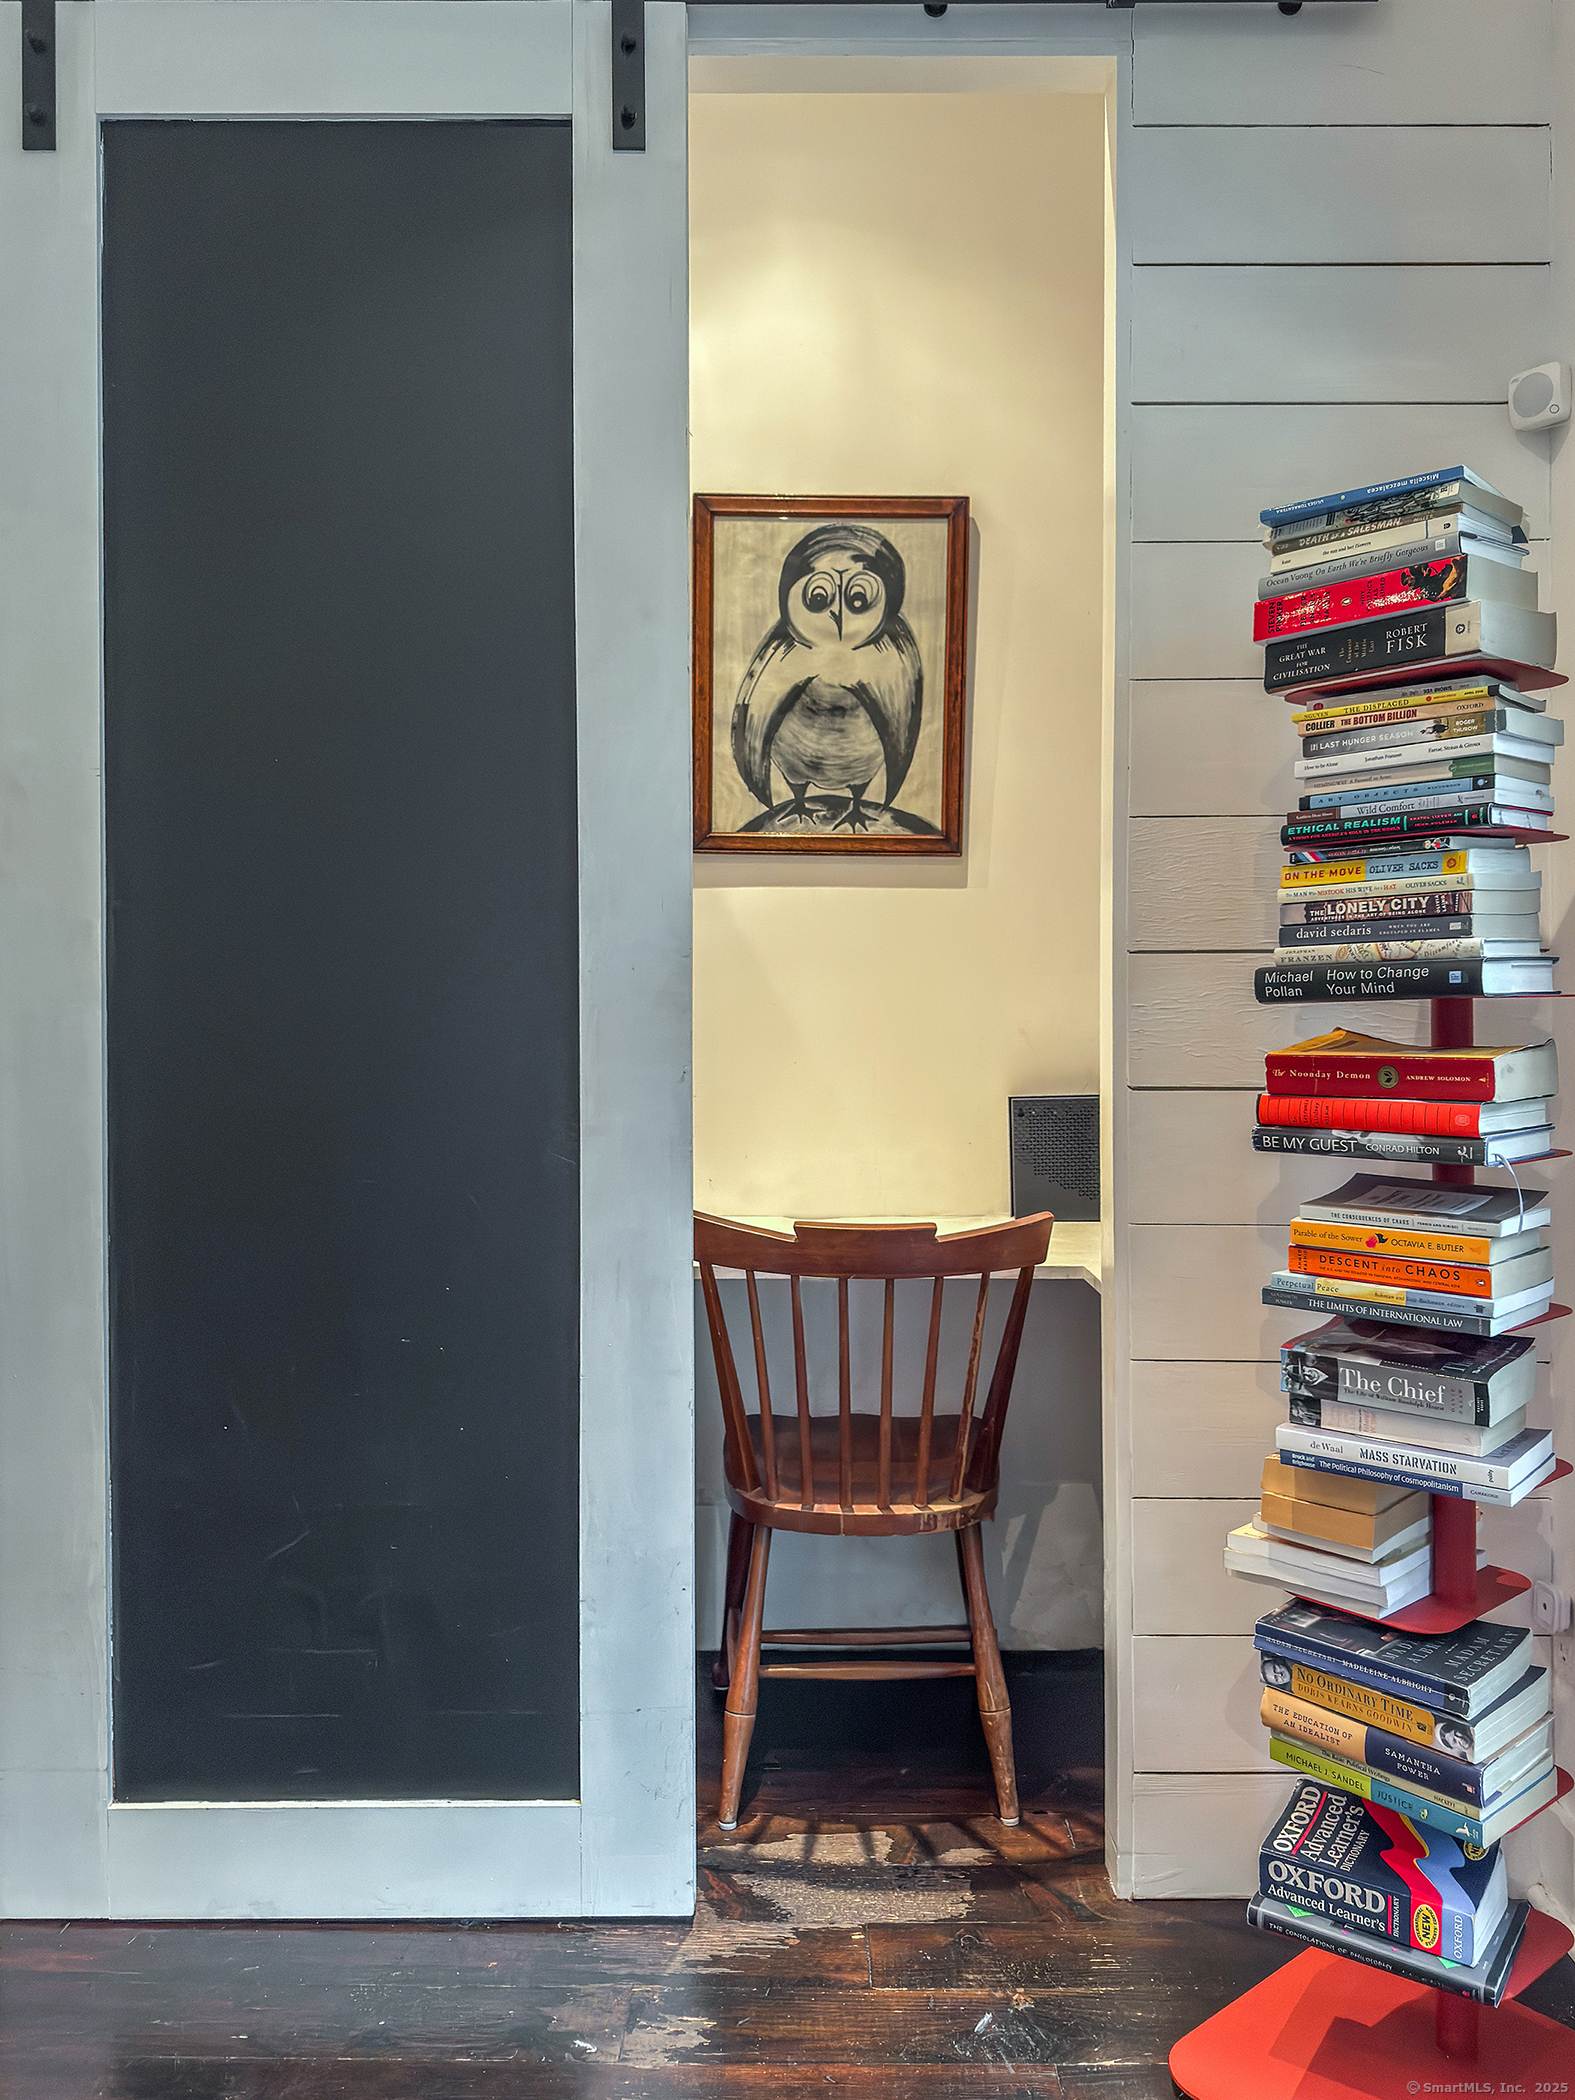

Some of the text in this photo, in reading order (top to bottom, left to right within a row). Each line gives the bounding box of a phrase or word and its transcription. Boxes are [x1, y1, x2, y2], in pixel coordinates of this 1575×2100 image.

[1409, 473, 1440, 485] Miscella
[1299, 531, 1329, 547] DEATH
[1348, 516, 1402, 536] SALESMAN
[1315, 568, 1326, 576] On
[1328, 562, 1347, 573] Earth
[1348, 558, 1368, 568] We're
[1370, 551, 1393, 562] Briefly
[1395, 544, 1429, 558] Gorgeous
[1266, 571, 1313, 587] Ocean Vuong
[1386, 622, 1428, 639] ROBERT
[1296, 643, 1308, 651] THE
[1386, 633, 1428, 654] FISK
[1279, 646, 1327, 663] GREAT WAR
[1272, 664, 1331, 681] CIVILISATION
[1364, 699, 1410, 710] DISPLACED
[1456, 702, 1484, 710] OXFORD
[1306, 720, 1335, 732] COLLIER
[1354, 713, 1386, 726] BOTTOM
[1387, 709, 1418, 720] BILLION
[1320, 730, 1414, 750] LAST HUNGER SEASON
[1318, 788, 1418, 804] ART OBJECTS
[1356, 803, 1376, 814] Wild
[1378, 796, 1414, 812] Comfort
[1288, 816, 1400, 835] ETHICAL REALISM
[1285, 866, 1361, 880] ON THE MOVE
[1370, 860, 1438, 874] OLIVER SACKS
[1327, 900, 1386, 915] LONELY
[1391, 896, 1430, 910] CITY
[1296, 924, 1372, 938] david sedaris
[1281, 954, 1333, 963] FRANZEN
[1265, 966, 1429, 984] Michael How to Change
[1266, 982, 1394, 998] Pollan Your Mind
[1272, 1068, 1371, 1080] The Noonday Demon
[1262, 1136, 1440, 1155] BE MY GUEST CONRAD HILTON
[1342, 1214, 1381, 1223] CONSEQUENCES
[1294, 1228, 1317, 1238] Parable
[1328, 1231, 1339, 1240] the
[1340, 1234, 1362, 1242] Sower
[1391, 1238, 1464, 1252] OCTAVIA E. BUTLER
[1320, 1255, 1460, 1281] DESCENT into CHAOS
[1276, 1278, 1339, 1293] Perpetual Peace
[1308, 1298, 1462, 1328] THE LIMITS OF INTERNATIONAL LAW
[1340, 1368, 1381, 1393] The
[1388, 1376, 1446, 1404] Chief
[1292, 1459, 1316, 1468] Brighouse
[1310, 1441, 1457, 1475] de Waal MASS STARVATION
[1320, 1460, 1331, 1469] The
[1332, 1462, 1356, 1474] Political
[1358, 1466, 1394, 1482] Philosophy
[1401, 1476, 1459, 1493] Cosmopolitanism
[1444, 1636, 1490, 1668] MADAM
[1454, 1630, 1519, 1682] SECRETARY
[1342, 1659, 1433, 1694] MADELEINE ALBRIGHT
[1297, 1668, 1413, 1722] NO ORDINARY TIME
[1298, 1684, 1412, 1733] DORIS KEARNS GOODWIN
[1273, 1704, 1353, 1740] THE EDUCATION OF
[1284, 1720, 1341, 1746] AN IDEALIST
[1384, 1748, 1441, 1776] SAMANTHA
[1396, 1762, 1430, 1780] POWER
[1286, 1752, 1322, 1774] MICHAEL
[1332, 1771, 1365, 1792] SANDEL
[1378, 1790, 1414, 1812] JUSTICE
[1272, 1786, 1322, 1852] OXFORD
[1300, 1793, 1348, 1862] Advanced
[1318, 1804, 1365, 1868] Learner's
[1340, 1830, 1370, 1872] DICTIONARY
[1268, 1860, 1386, 1914] OXFORD
[1268, 1883, 1386, 1934] Advanced Learner's
[1421, 1912, 1432, 1940] NEW
[1268, 1922, 1284, 1932] THE
[1285, 1928, 1335, 1950] CONSOLATIONS
[1350, 1950, 1393, 1970] PHILOSOPHY
[1453, 1915, 1464, 1959] OXFORD
